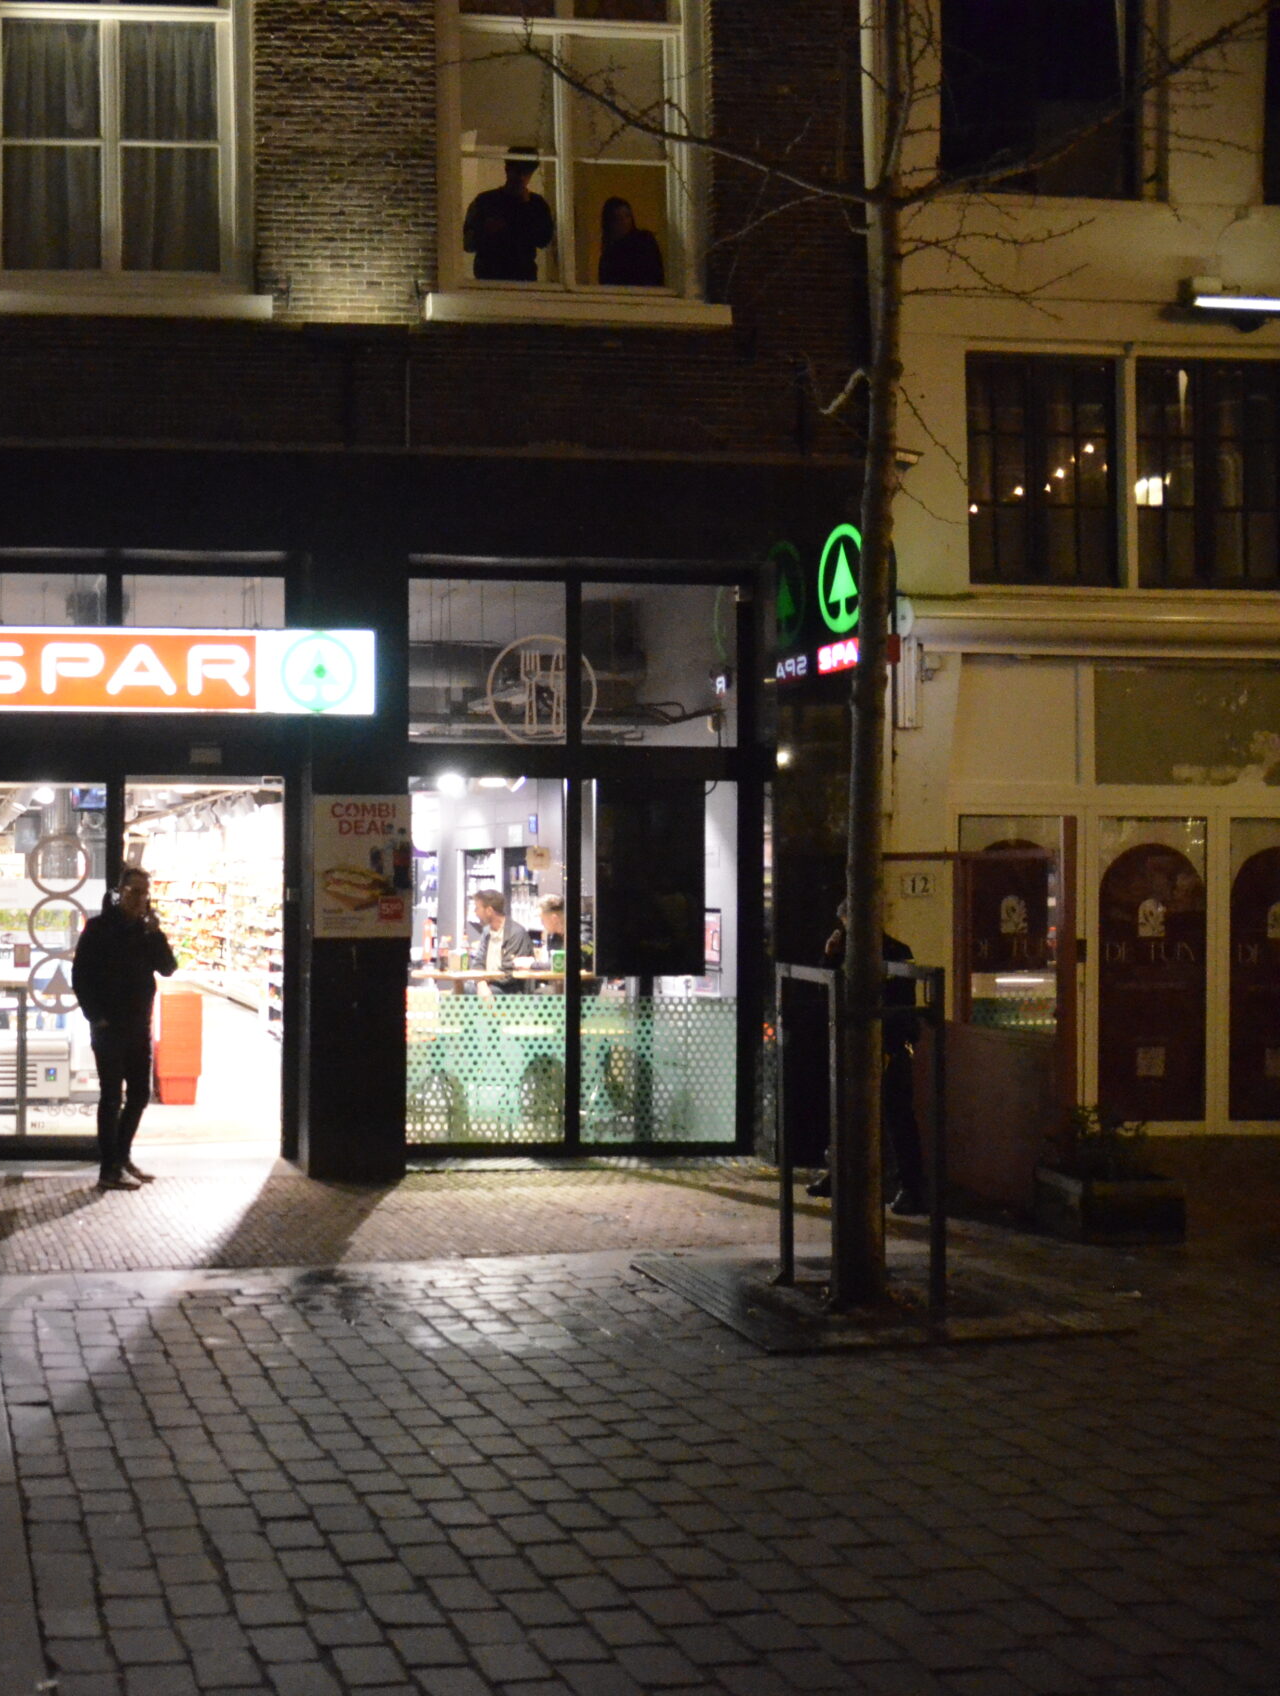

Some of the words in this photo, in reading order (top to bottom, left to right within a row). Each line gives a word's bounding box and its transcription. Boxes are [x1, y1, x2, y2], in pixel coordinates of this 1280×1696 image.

[818, 640, 858, 672] SPA
[331, 802, 396, 818] COMBI
[338, 820, 392, 836] DEAL
[911, 876, 930, 893] 12
